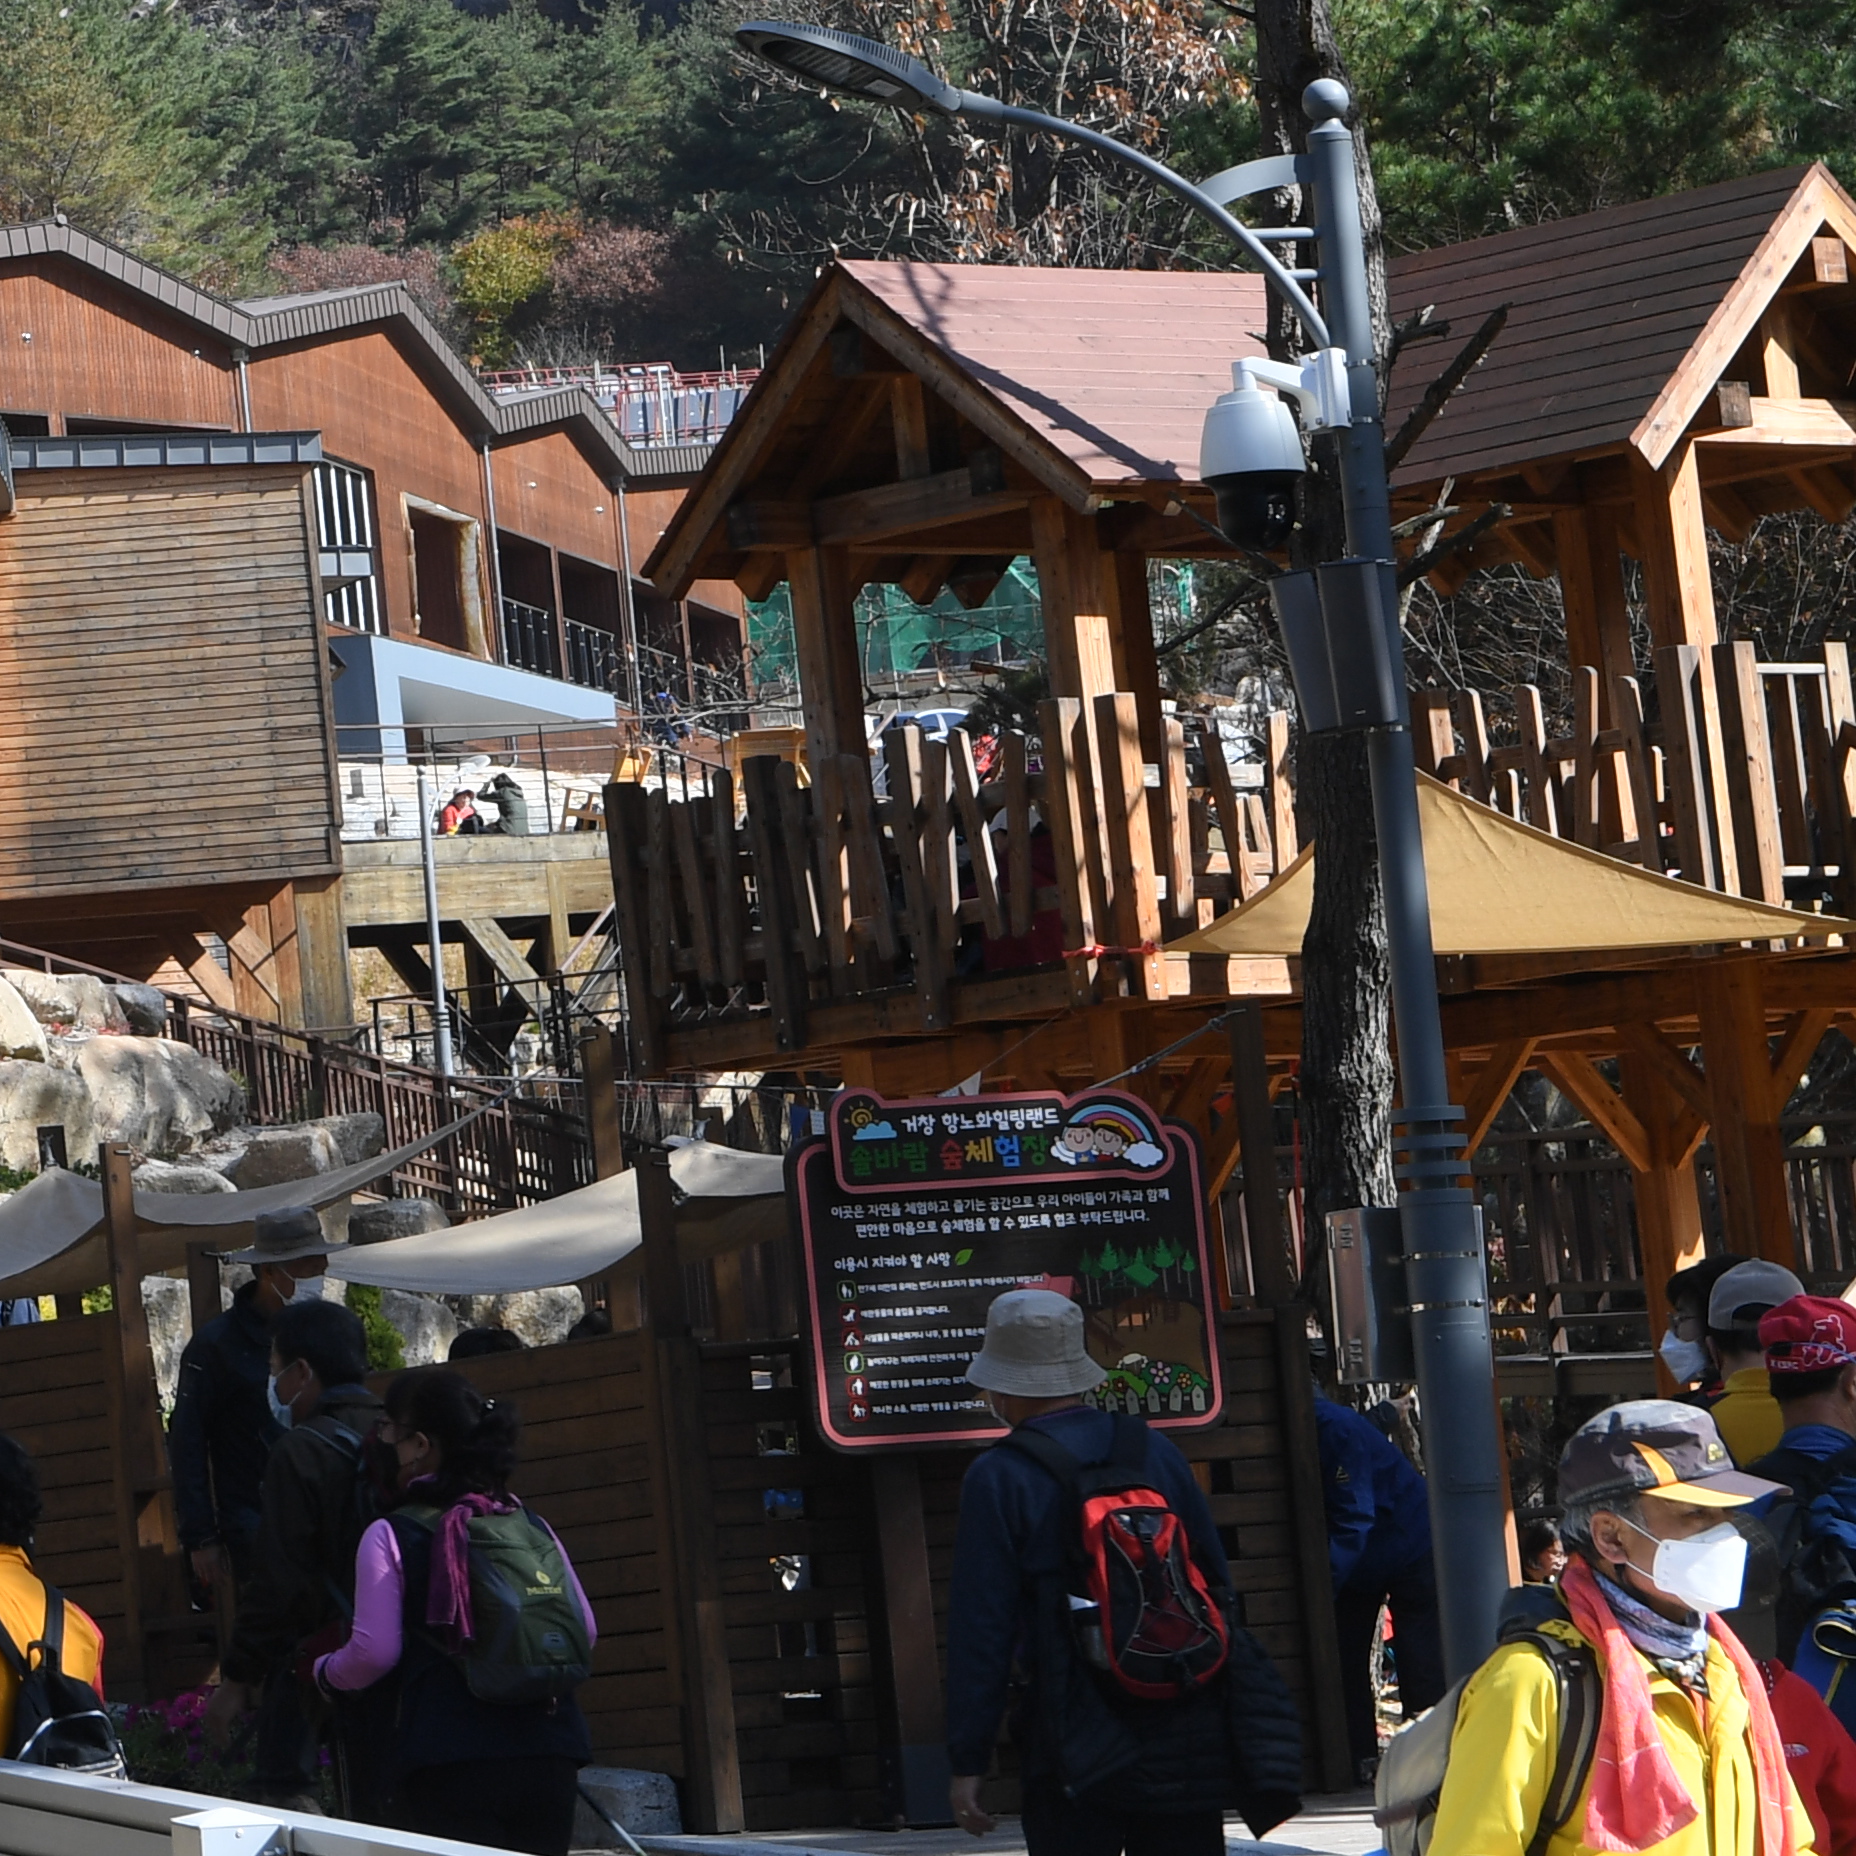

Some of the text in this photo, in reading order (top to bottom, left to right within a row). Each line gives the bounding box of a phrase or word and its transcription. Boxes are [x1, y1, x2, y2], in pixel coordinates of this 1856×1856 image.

[901, 1107, 1060, 1136] 거창 항노화힐링랜드
[849, 1133, 1049, 1177] 솔바람 숲체험장
[830, 1187, 1170, 1219] 이곳은 자연을 체험하고 즐기는 공간으로 우리 아이들이 가족과 함께
[855, 1209, 1150, 1238] 편안한 마음으로 숲체험을 할 수 있도록 협조 부탁드립니다.
[834, 1252, 951, 1273] 이용시 지켜야 할 사항
